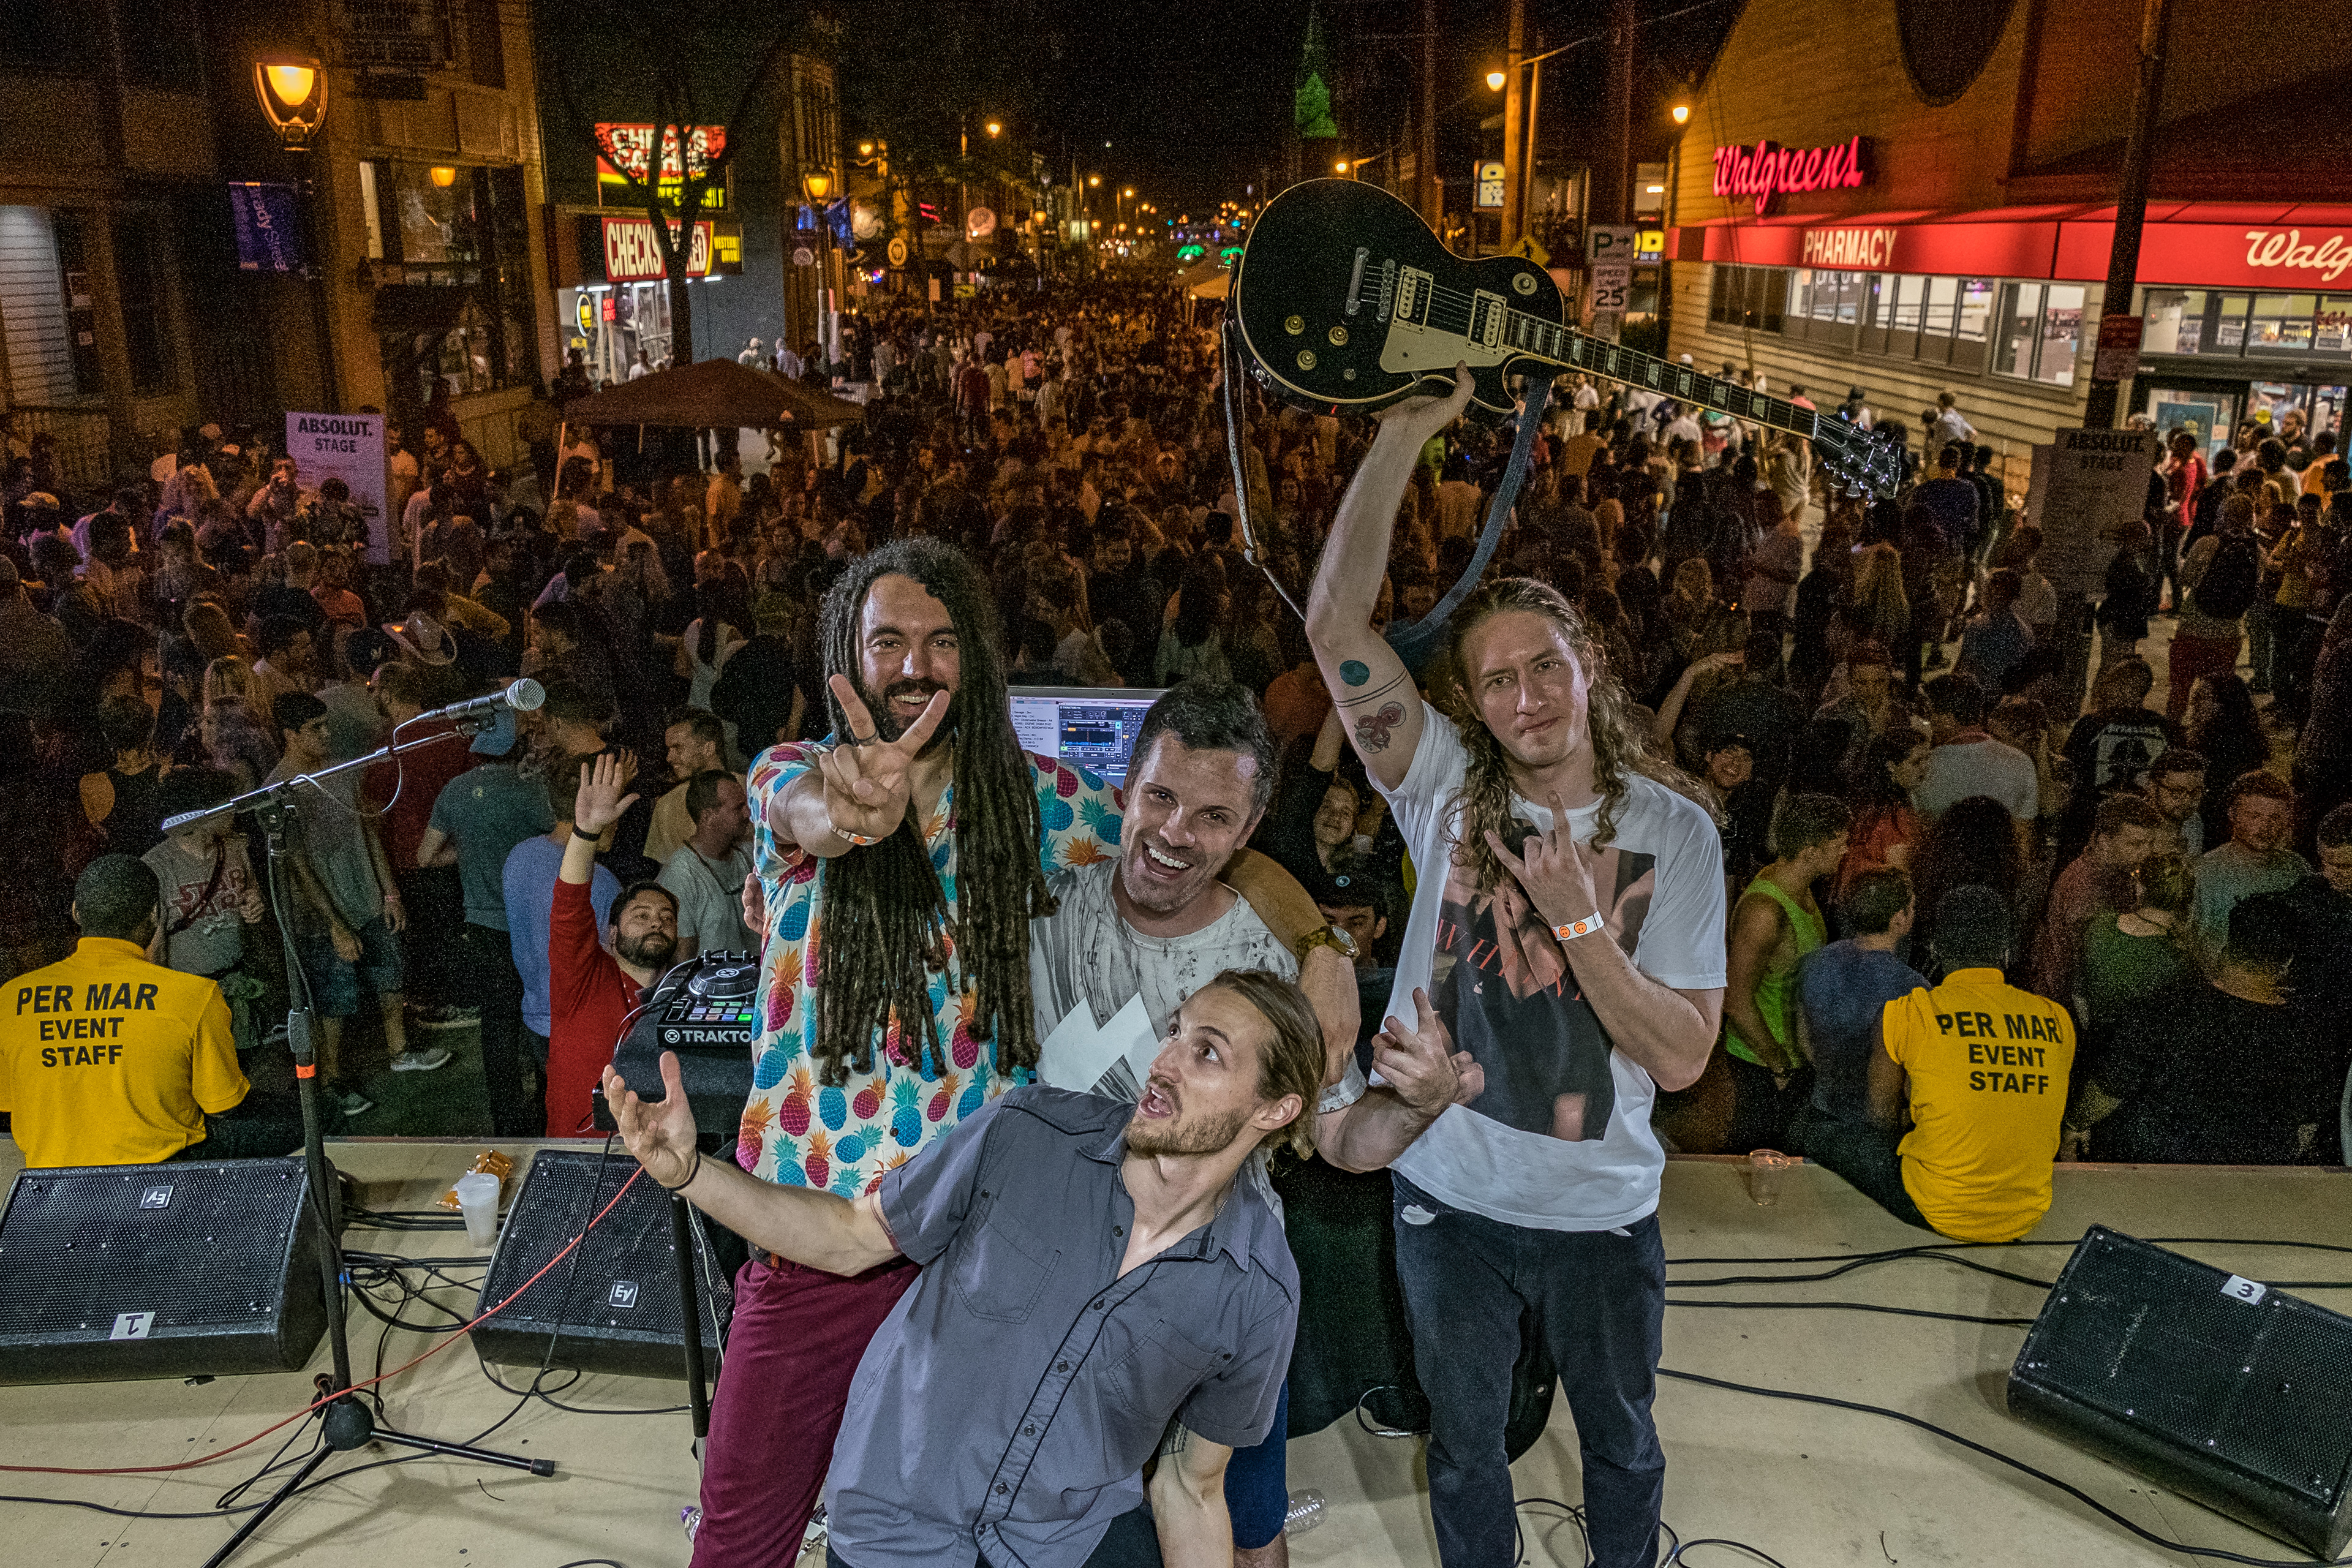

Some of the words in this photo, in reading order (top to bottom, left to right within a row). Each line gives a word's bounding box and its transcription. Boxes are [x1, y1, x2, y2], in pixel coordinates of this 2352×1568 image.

[1713, 135, 1863, 214] Walgreens
[606, 222, 663, 277] CHECKS
[1594, 232, 1613, 258] P
[1803, 228, 1898, 267] PHARMACY
[2245, 229, 2352, 282] Walg
[1596, 286, 1627, 306] 25
[314, 437, 356, 453] STAGE
[17, 985, 74, 1016] PER
[85, 983, 159, 1011] MAR
[40, 1017, 124, 1041] EVENT
[682, 1030, 752, 1042] TRAKTO
[1935, 1011, 1997, 1038] PER
[2003, 1014, 2062, 1044] MAR
[41, 1044, 123, 1068] STAFF
[1969, 1043, 2045, 1068] EVENT
[1969, 1071, 2049, 1095] STAFF
[2237, 1283, 2255, 1298] 3
[126, 1314, 144, 1336] 1
